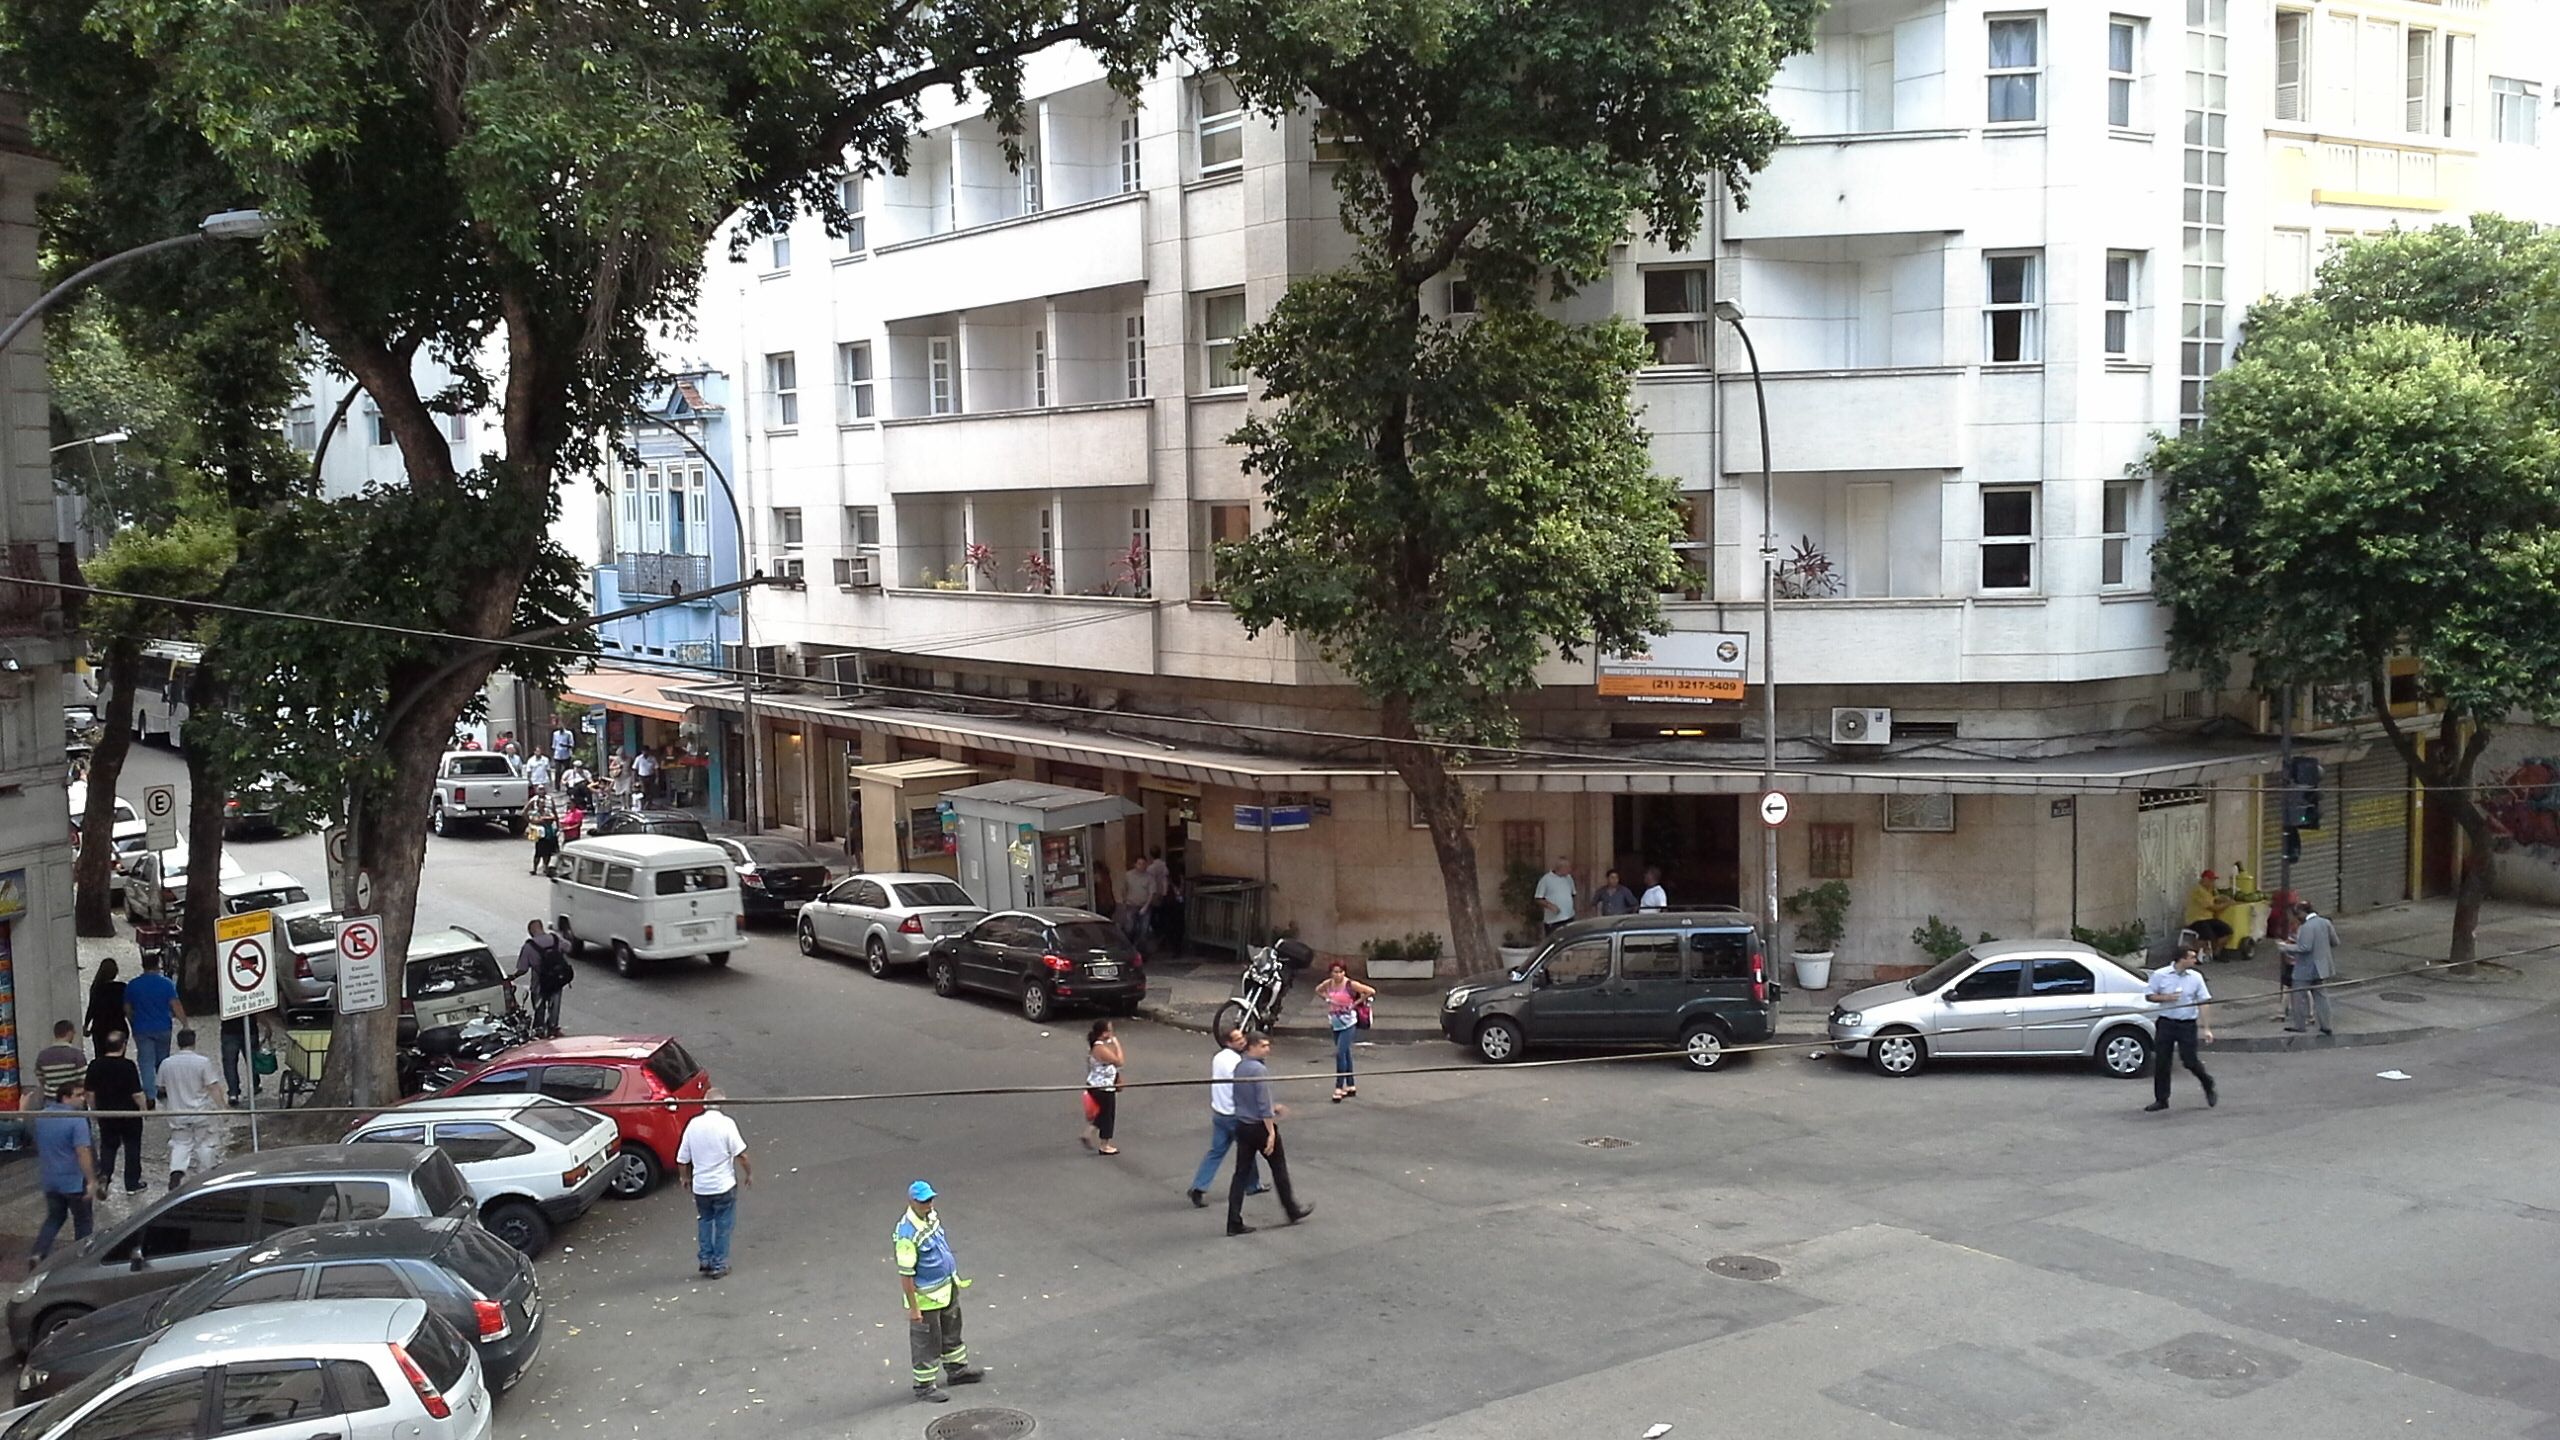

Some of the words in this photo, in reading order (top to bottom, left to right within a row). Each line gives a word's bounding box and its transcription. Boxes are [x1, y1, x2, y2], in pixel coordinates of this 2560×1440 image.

[1652, 679, 1674, 690] (21)
[1678, 680, 1737, 691] 3217-5409
[155, 794, 165, 811] E
[232, 993, 247, 1004] Dias
